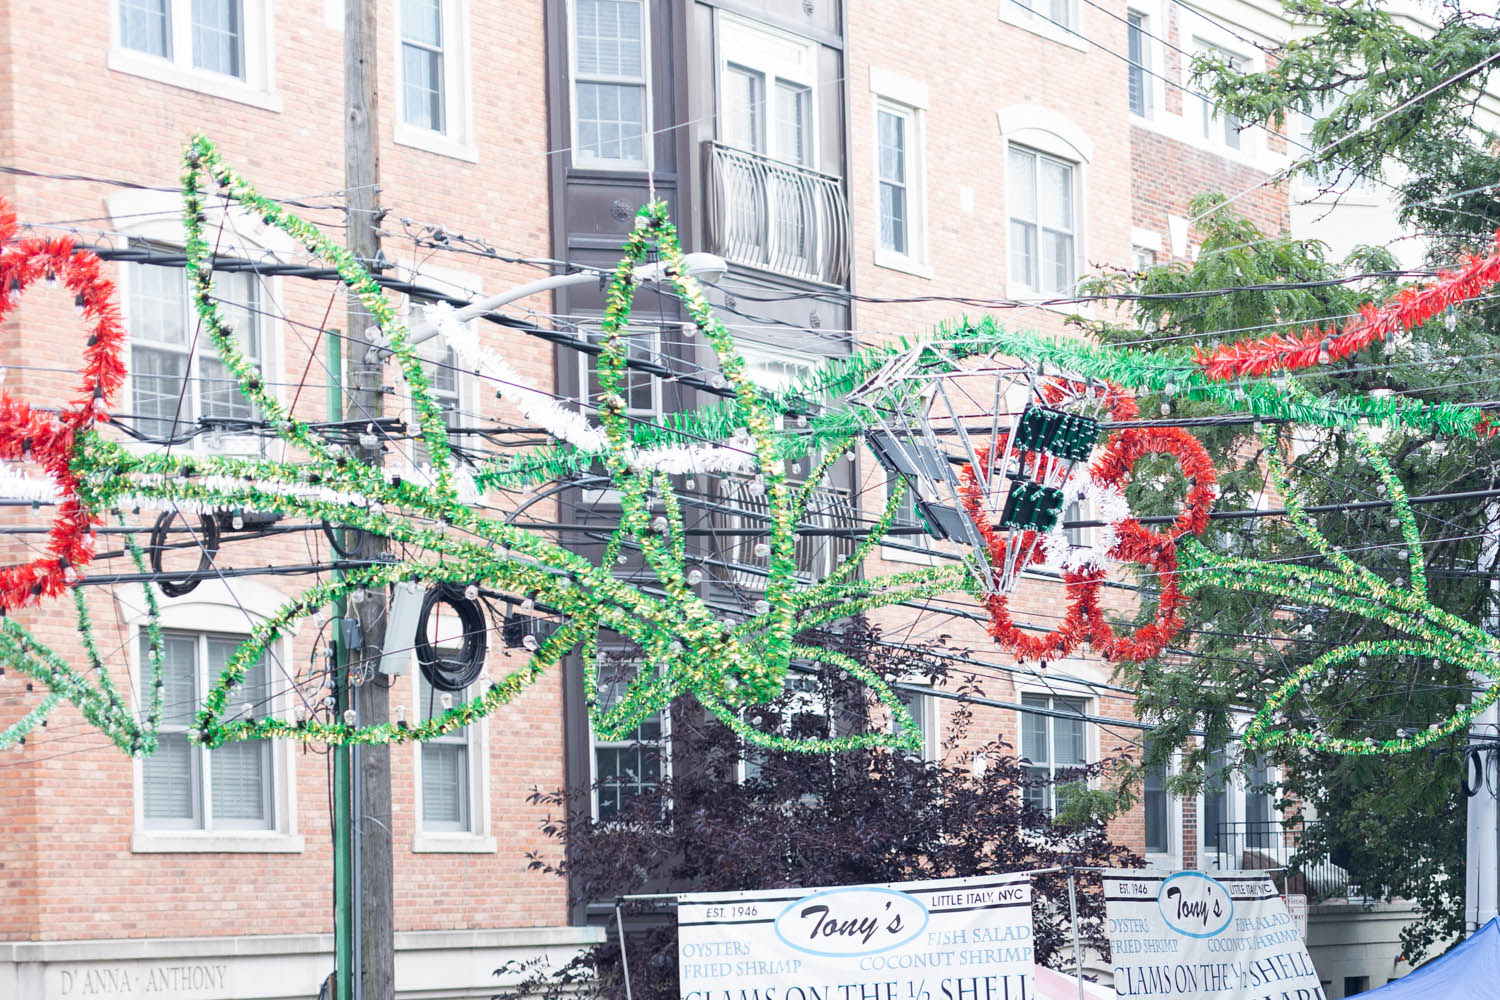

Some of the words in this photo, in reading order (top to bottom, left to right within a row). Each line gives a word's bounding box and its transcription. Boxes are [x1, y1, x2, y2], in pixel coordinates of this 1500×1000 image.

[932, 894, 963, 907] LITTLE
[967, 891, 994, 905] ITALY,
[998, 888, 1024, 901] NYC
[1133, 883, 1148, 895] 1946
[706, 907, 726, 919] EST.
[732, 906, 758, 918] 1946
[1167, 886, 1223, 927] Tony's
[801, 901, 905, 945] Tony's
[928, 930, 967, 945] FISH
[973, 926, 1031, 943] SALAD
[682, 941, 751, 958] OYSTERS
[1110, 939, 1141, 954] FRIED
[1143, 938, 1178, 953] SHRIMP
[860, 952, 955, 971] COCONUT
[960, 947, 1032, 966] SHRIMP
[684, 962, 732, 979] FRIED
[737, 959, 803, 977] SHRIMP
[1114, 964, 1172, 996] CLAMS
[1175, 964, 1198, 993] ON
[1200, 963, 1233, 992] THE
[1249, 952, 1315, 988] SHELL
[60, 968, 132, 996] D'ANNA
[146, 965, 228, 992] ANTHONY
